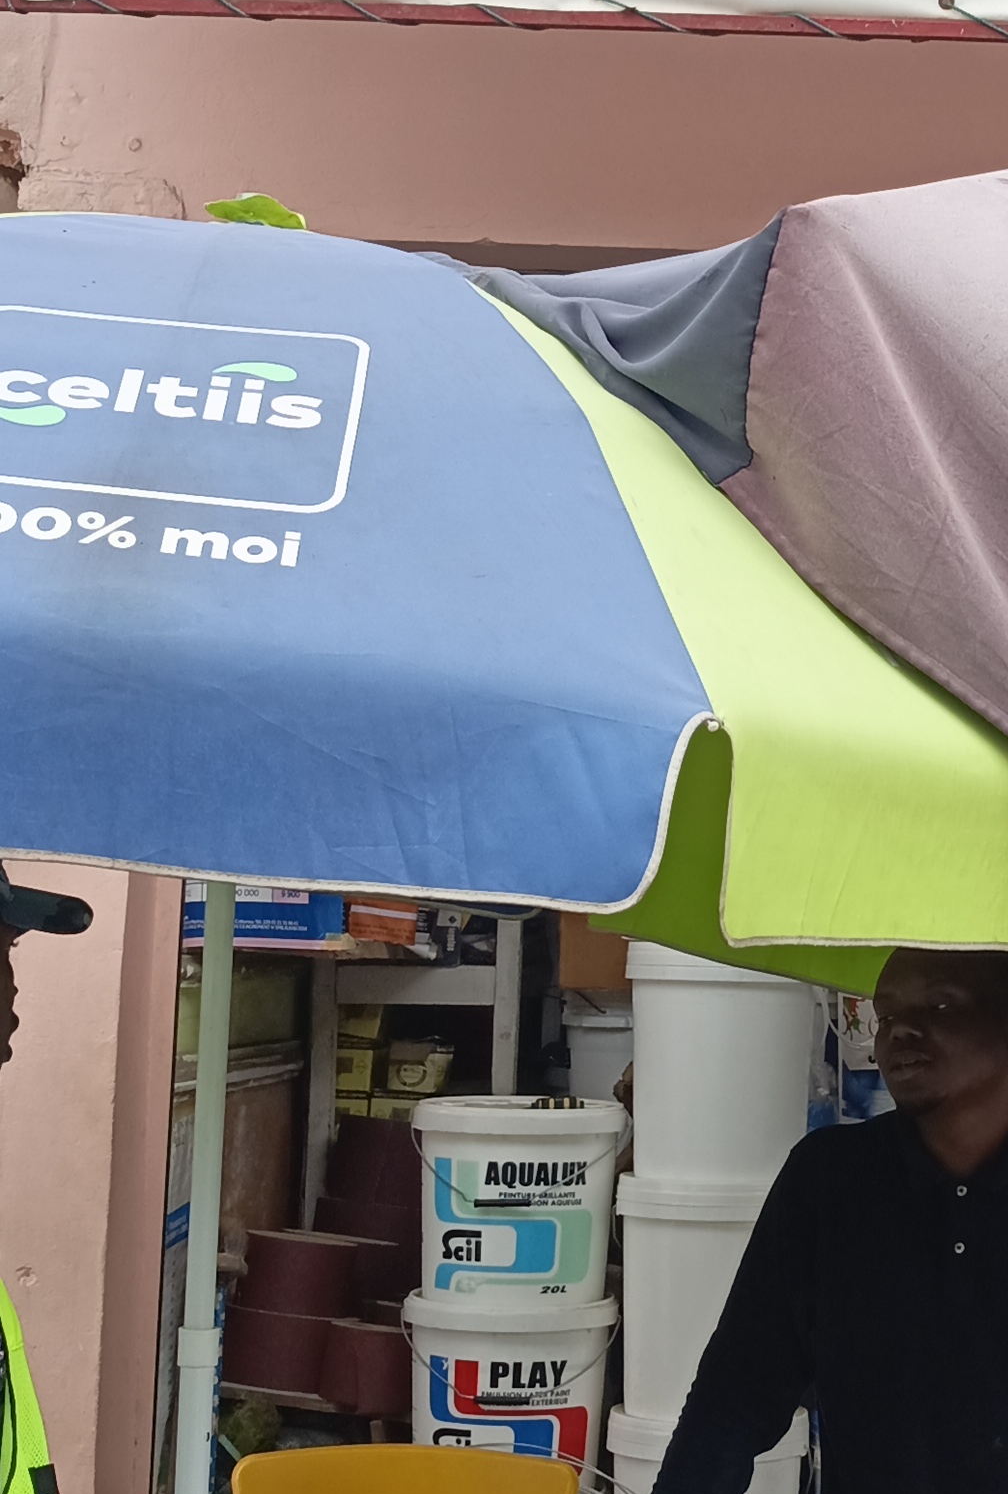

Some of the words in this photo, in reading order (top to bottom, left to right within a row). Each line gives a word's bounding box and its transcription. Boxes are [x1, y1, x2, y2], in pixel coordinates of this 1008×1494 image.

[0, 368, 323, 429] celtiis
[160, 523, 301, 567] moi
[485, 1161, 587, 1188] AQUALUX
[442, 1229, 482, 1262] Scil
[540, 1285, 567, 1294] 20L
[490, 1360, 568, 1389] PLAY
